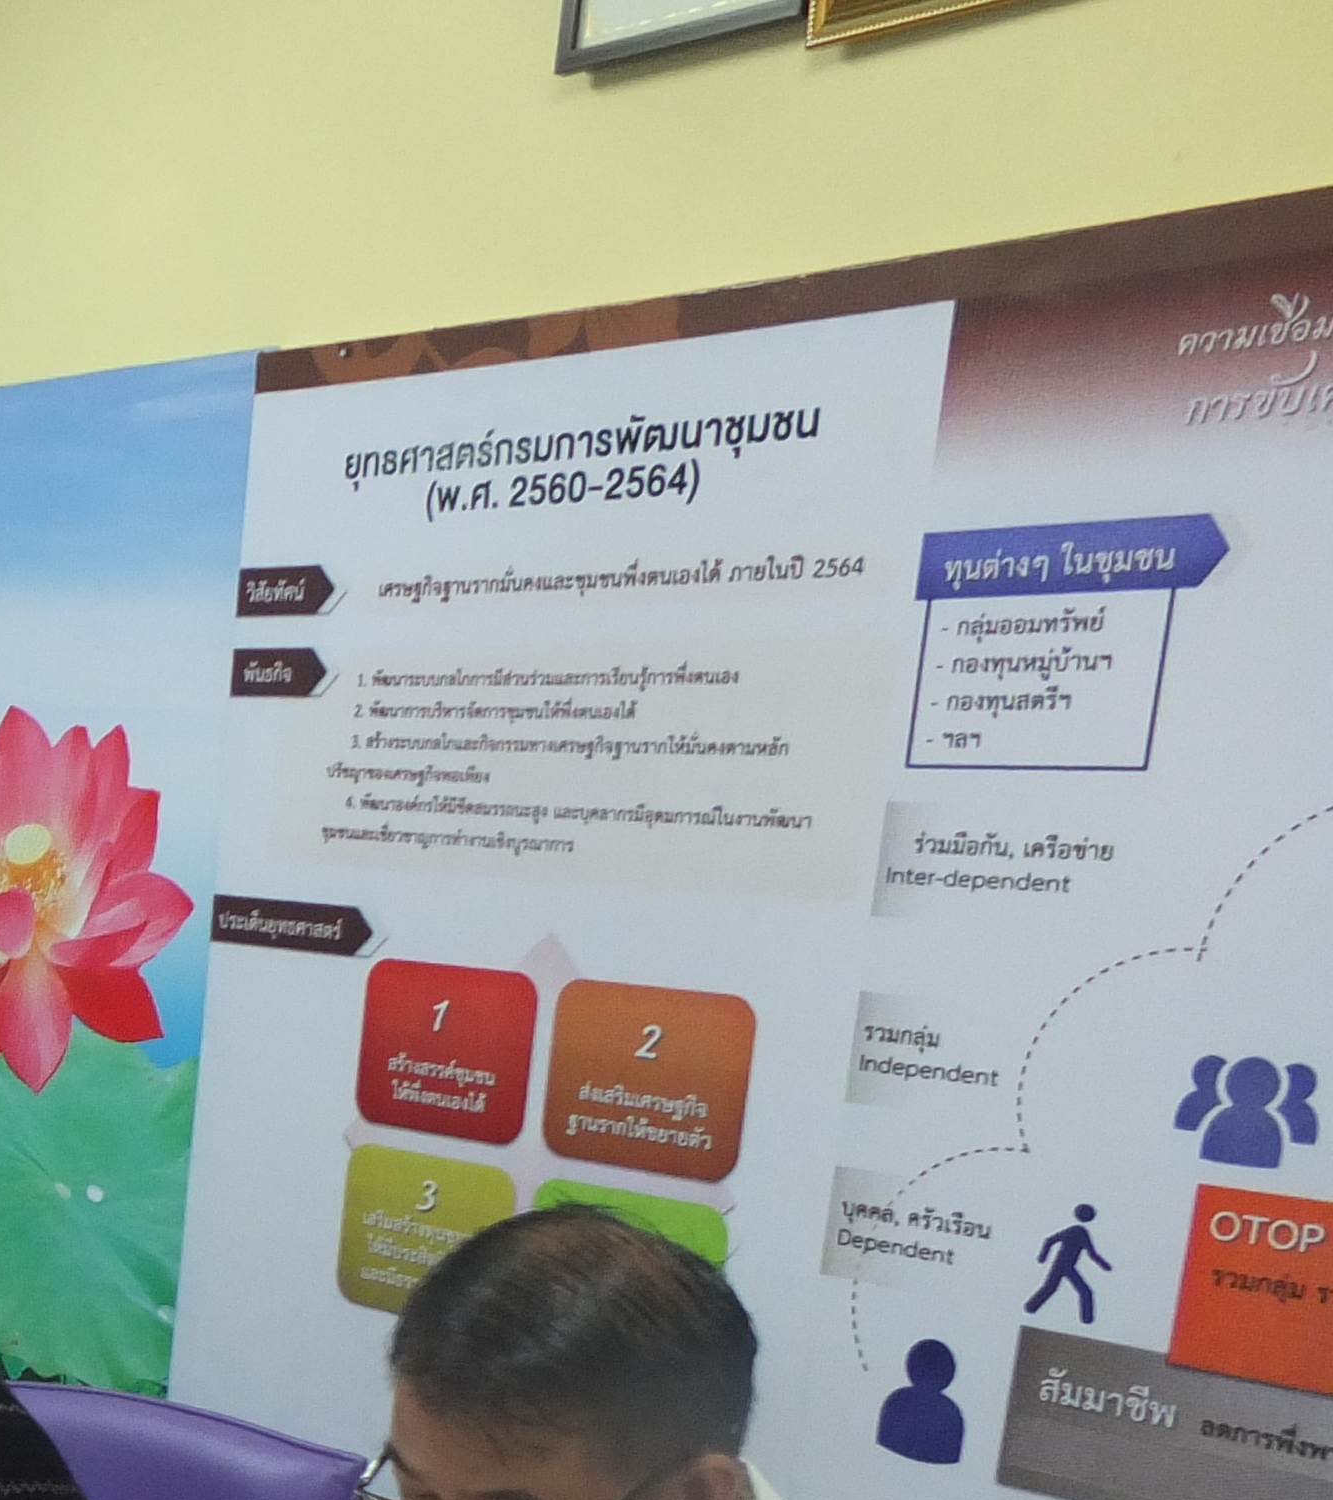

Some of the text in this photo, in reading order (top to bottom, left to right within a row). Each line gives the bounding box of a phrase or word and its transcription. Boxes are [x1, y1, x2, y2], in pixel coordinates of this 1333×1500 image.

[344, 407, 821, 492] ยุทธศาสตร์กรมการพัฒนาชุมชน
[426, 459, 701, 522] (พ.ศ. 2560-2564)
[728, 554, 804, 583] ภายในปี
[812, 555, 865, 579] 2564
[944, 541, 1176, 591] ทุนต่างๆ ในชุมชน
[956, 605, 1108, 643] กลุ่มออมทรัพย์
[243, 660, 293, 684] พันธกิจ
[951, 646, 1113, 681] กองทุนหมู่บ้านฯ
[946, 686, 1072, 718] กองทุนสตรีฯ
[942, 731, 981, 749] ฯลฯ
[914, 831, 1115, 861] ร่วมมือกัน, เครือข่าย
[885, 866, 1071, 893] Inter-dependent
[432, 999, 451, 1032] 1
[634, 1024, 662, 1059] 2
[863, 1024, 940, 1053] รวมกลุ่ม
[858, 1055, 999, 1087] Independent
[415, 1180, 439, 1212] 3
[841, 1200, 991, 1239] บุคคล, ครัวเรือน
[1210, 1211, 1326, 1253] OTOP
[837, 1228, 955, 1266] Dependent
[1039, 1367, 1177, 1428] สัมมาชีพ
